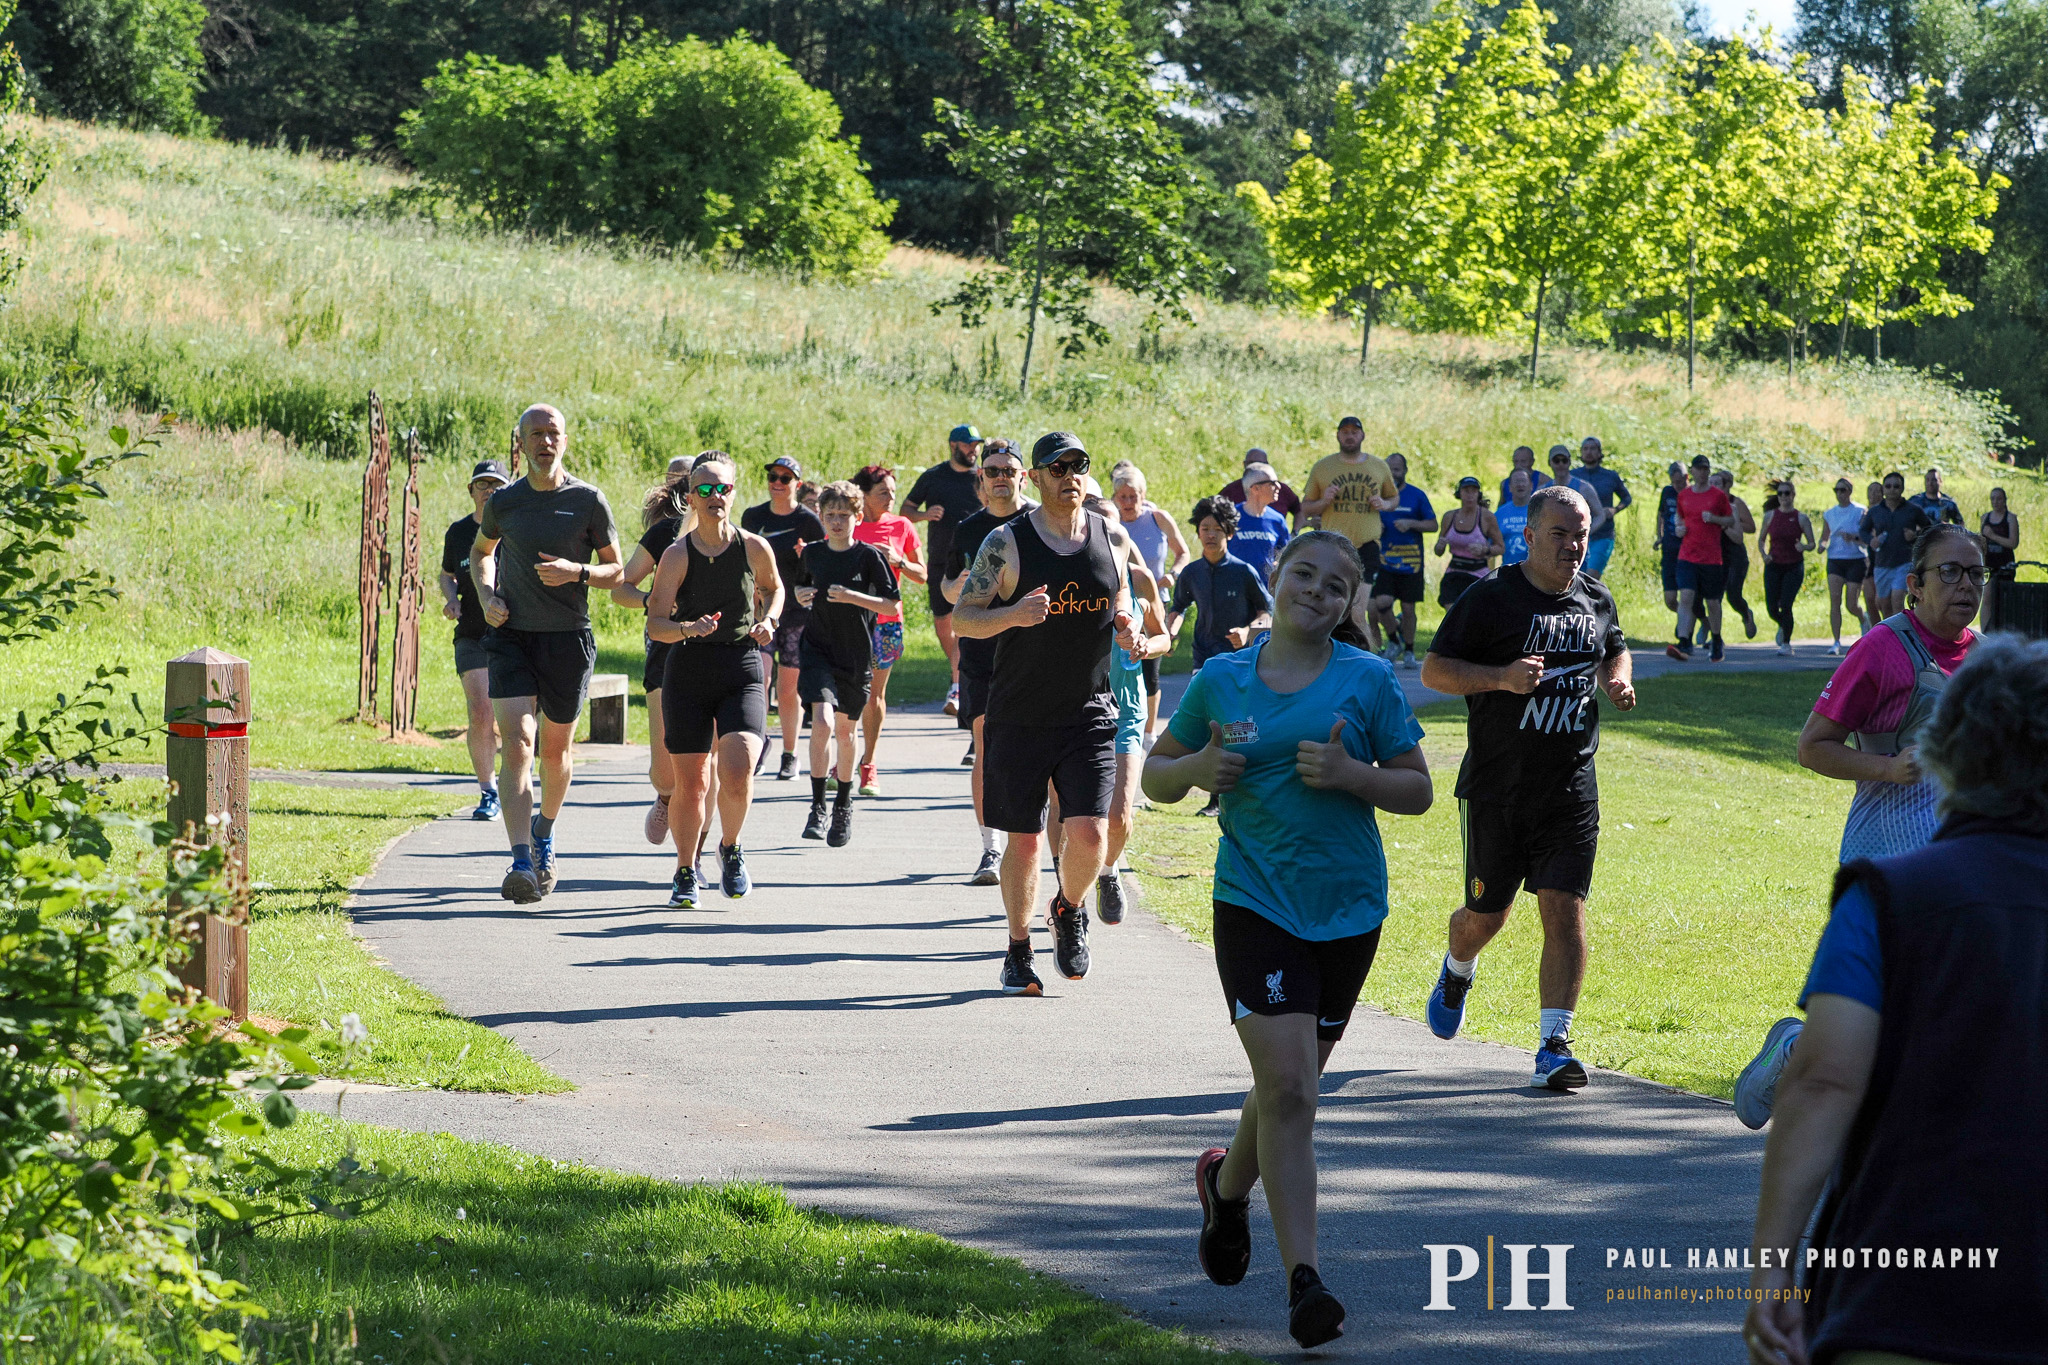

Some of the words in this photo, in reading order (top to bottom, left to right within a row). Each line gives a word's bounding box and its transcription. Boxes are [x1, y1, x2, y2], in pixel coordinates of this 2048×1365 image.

[1332, 472, 1379, 496] UHAMMAD
[1342, 485, 1366, 501] ALI
[1048, 581, 1109, 615] arkrun
[1523, 614, 1596, 653] NIKE
[1555, 675, 1589, 690] AIR
[1519, 696, 1590, 734] NIKE
